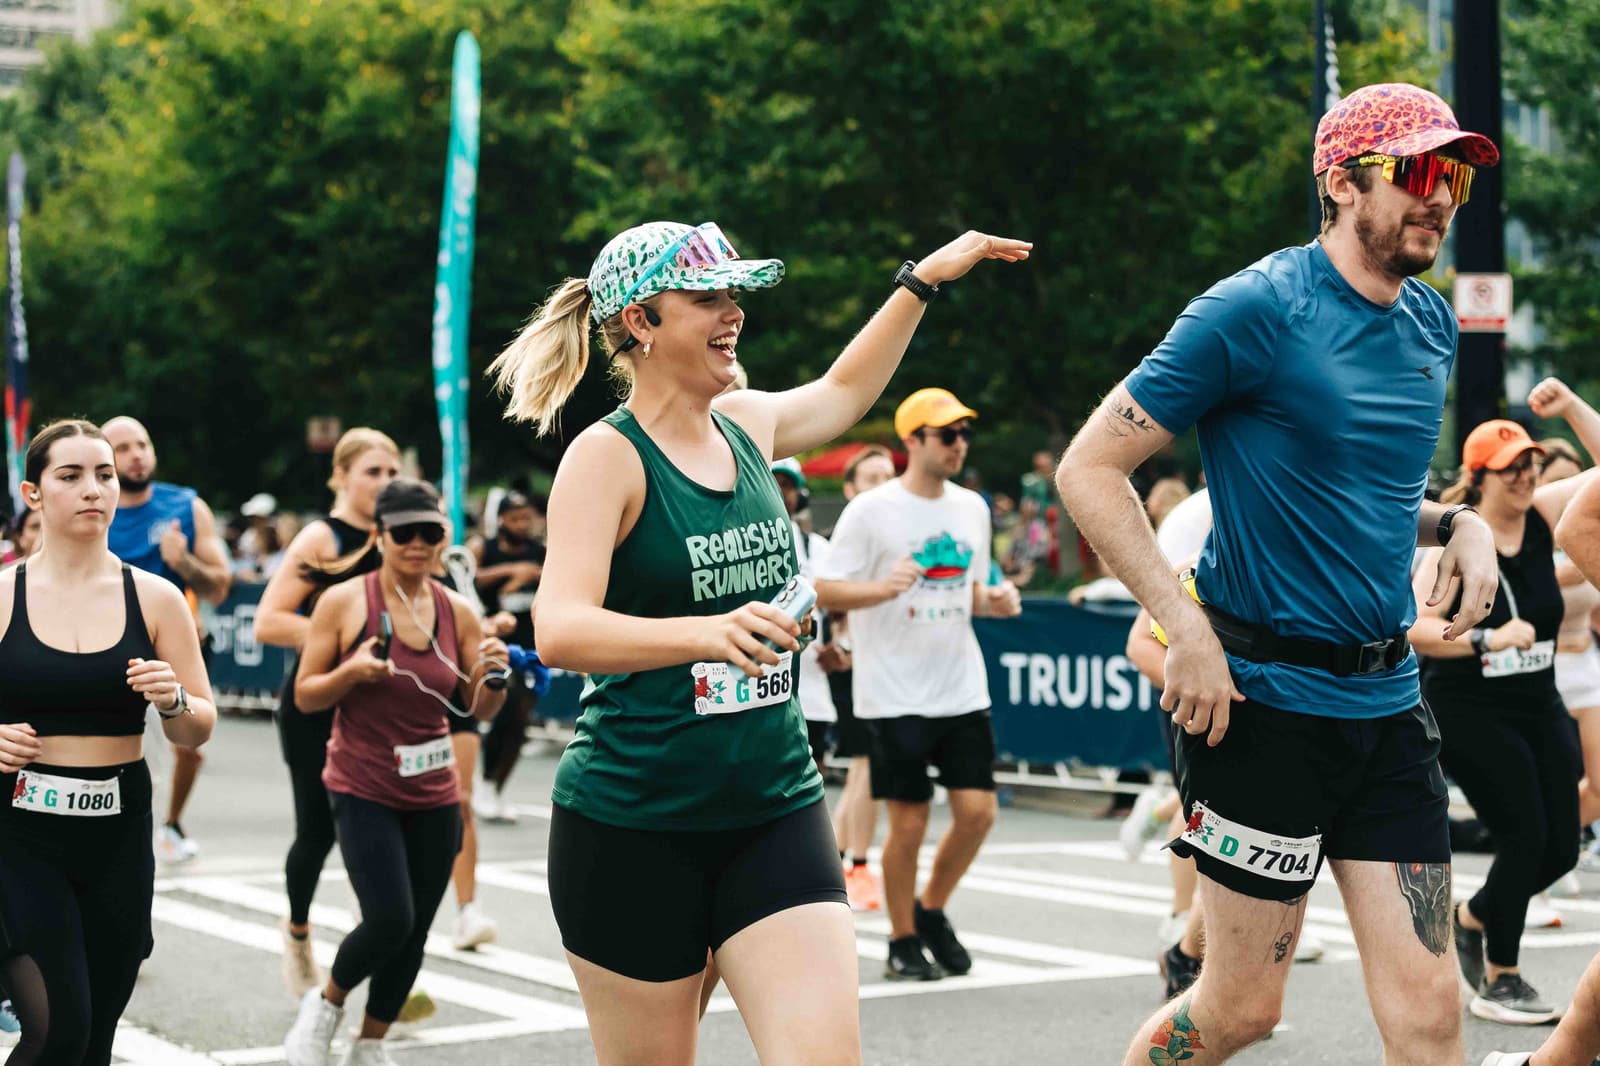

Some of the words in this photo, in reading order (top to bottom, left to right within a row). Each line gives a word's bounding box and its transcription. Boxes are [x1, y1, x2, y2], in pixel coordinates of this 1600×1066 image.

[736, 674, 750, 703] G
[757, 669, 790, 700] 568
[1000, 652, 1151, 711] TRUIST
[44, 788, 58, 807] G
[66, 791, 114, 810] 1080
[1219, 834, 1240, 858] D
[1247, 844, 1310, 874] 7704
